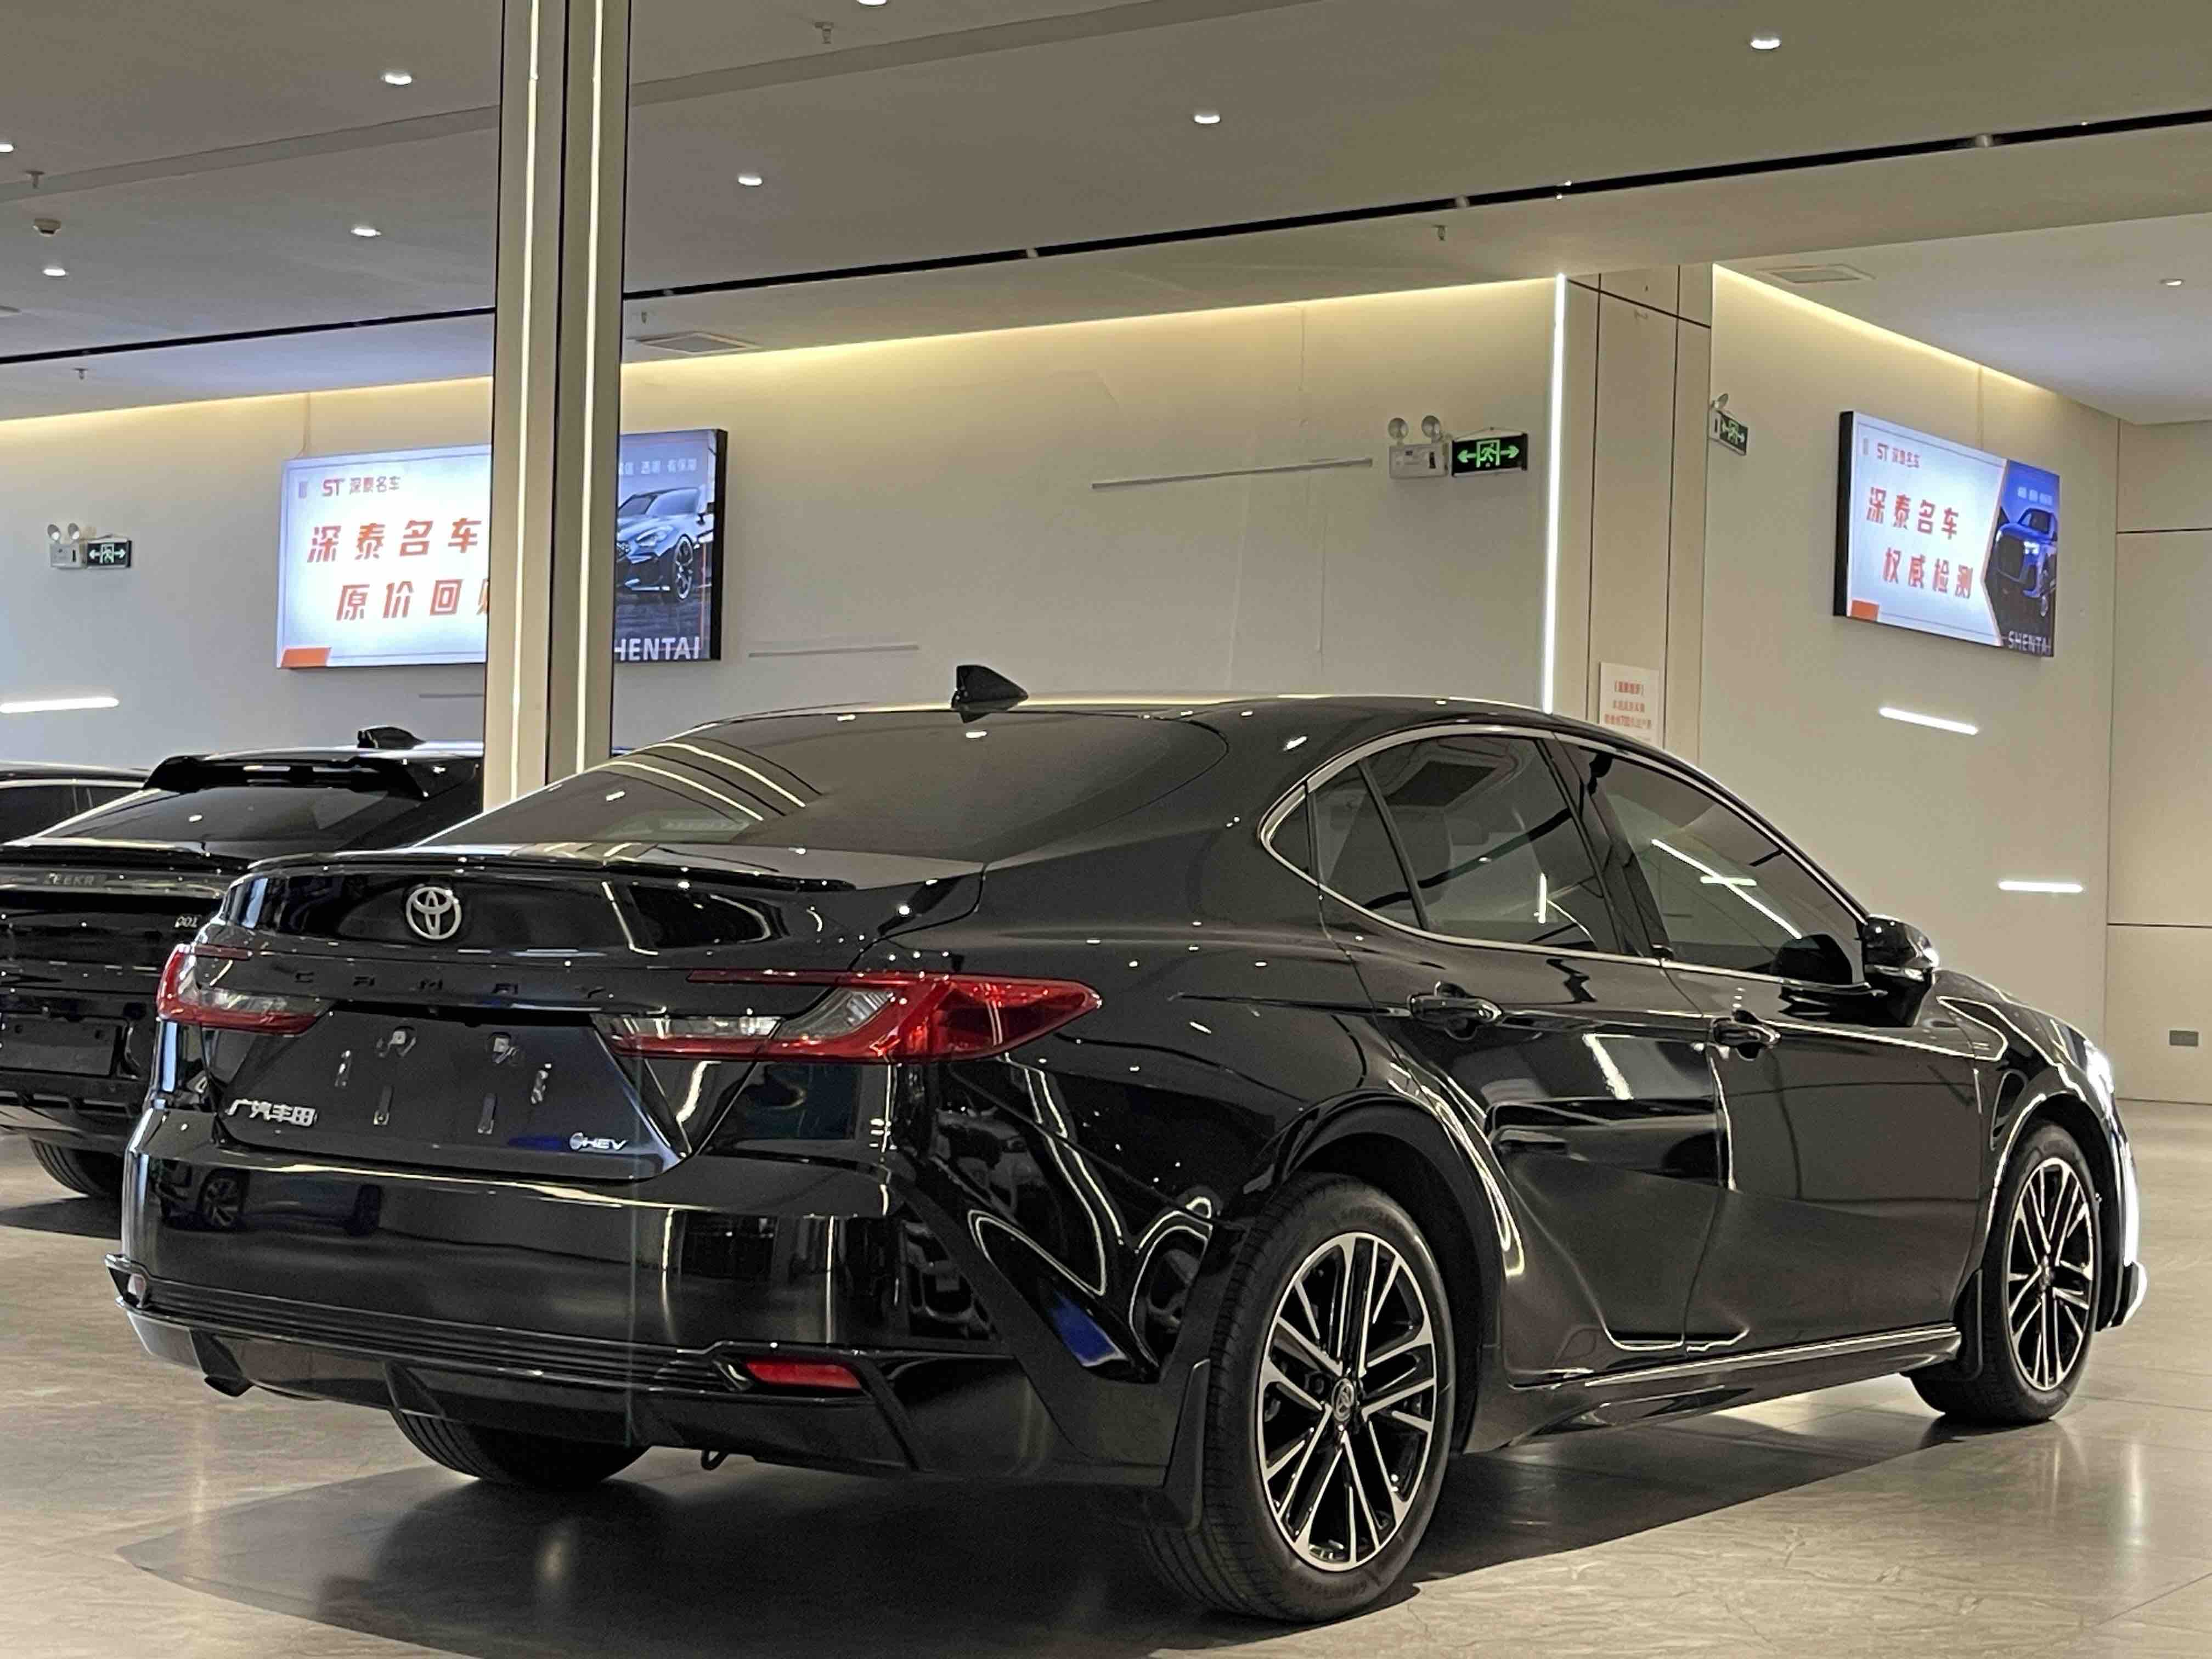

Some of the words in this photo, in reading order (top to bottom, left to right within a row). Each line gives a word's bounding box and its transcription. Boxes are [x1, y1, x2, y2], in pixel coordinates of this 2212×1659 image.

[1877, 443, 1888, 461] ST
[321, 478, 345, 496] ST
[1866, 486, 1959, 540] 深泰名车
[307, 517, 483, 563] 深泰名车
[224, 1098, 317, 1127] 广汽丰田
